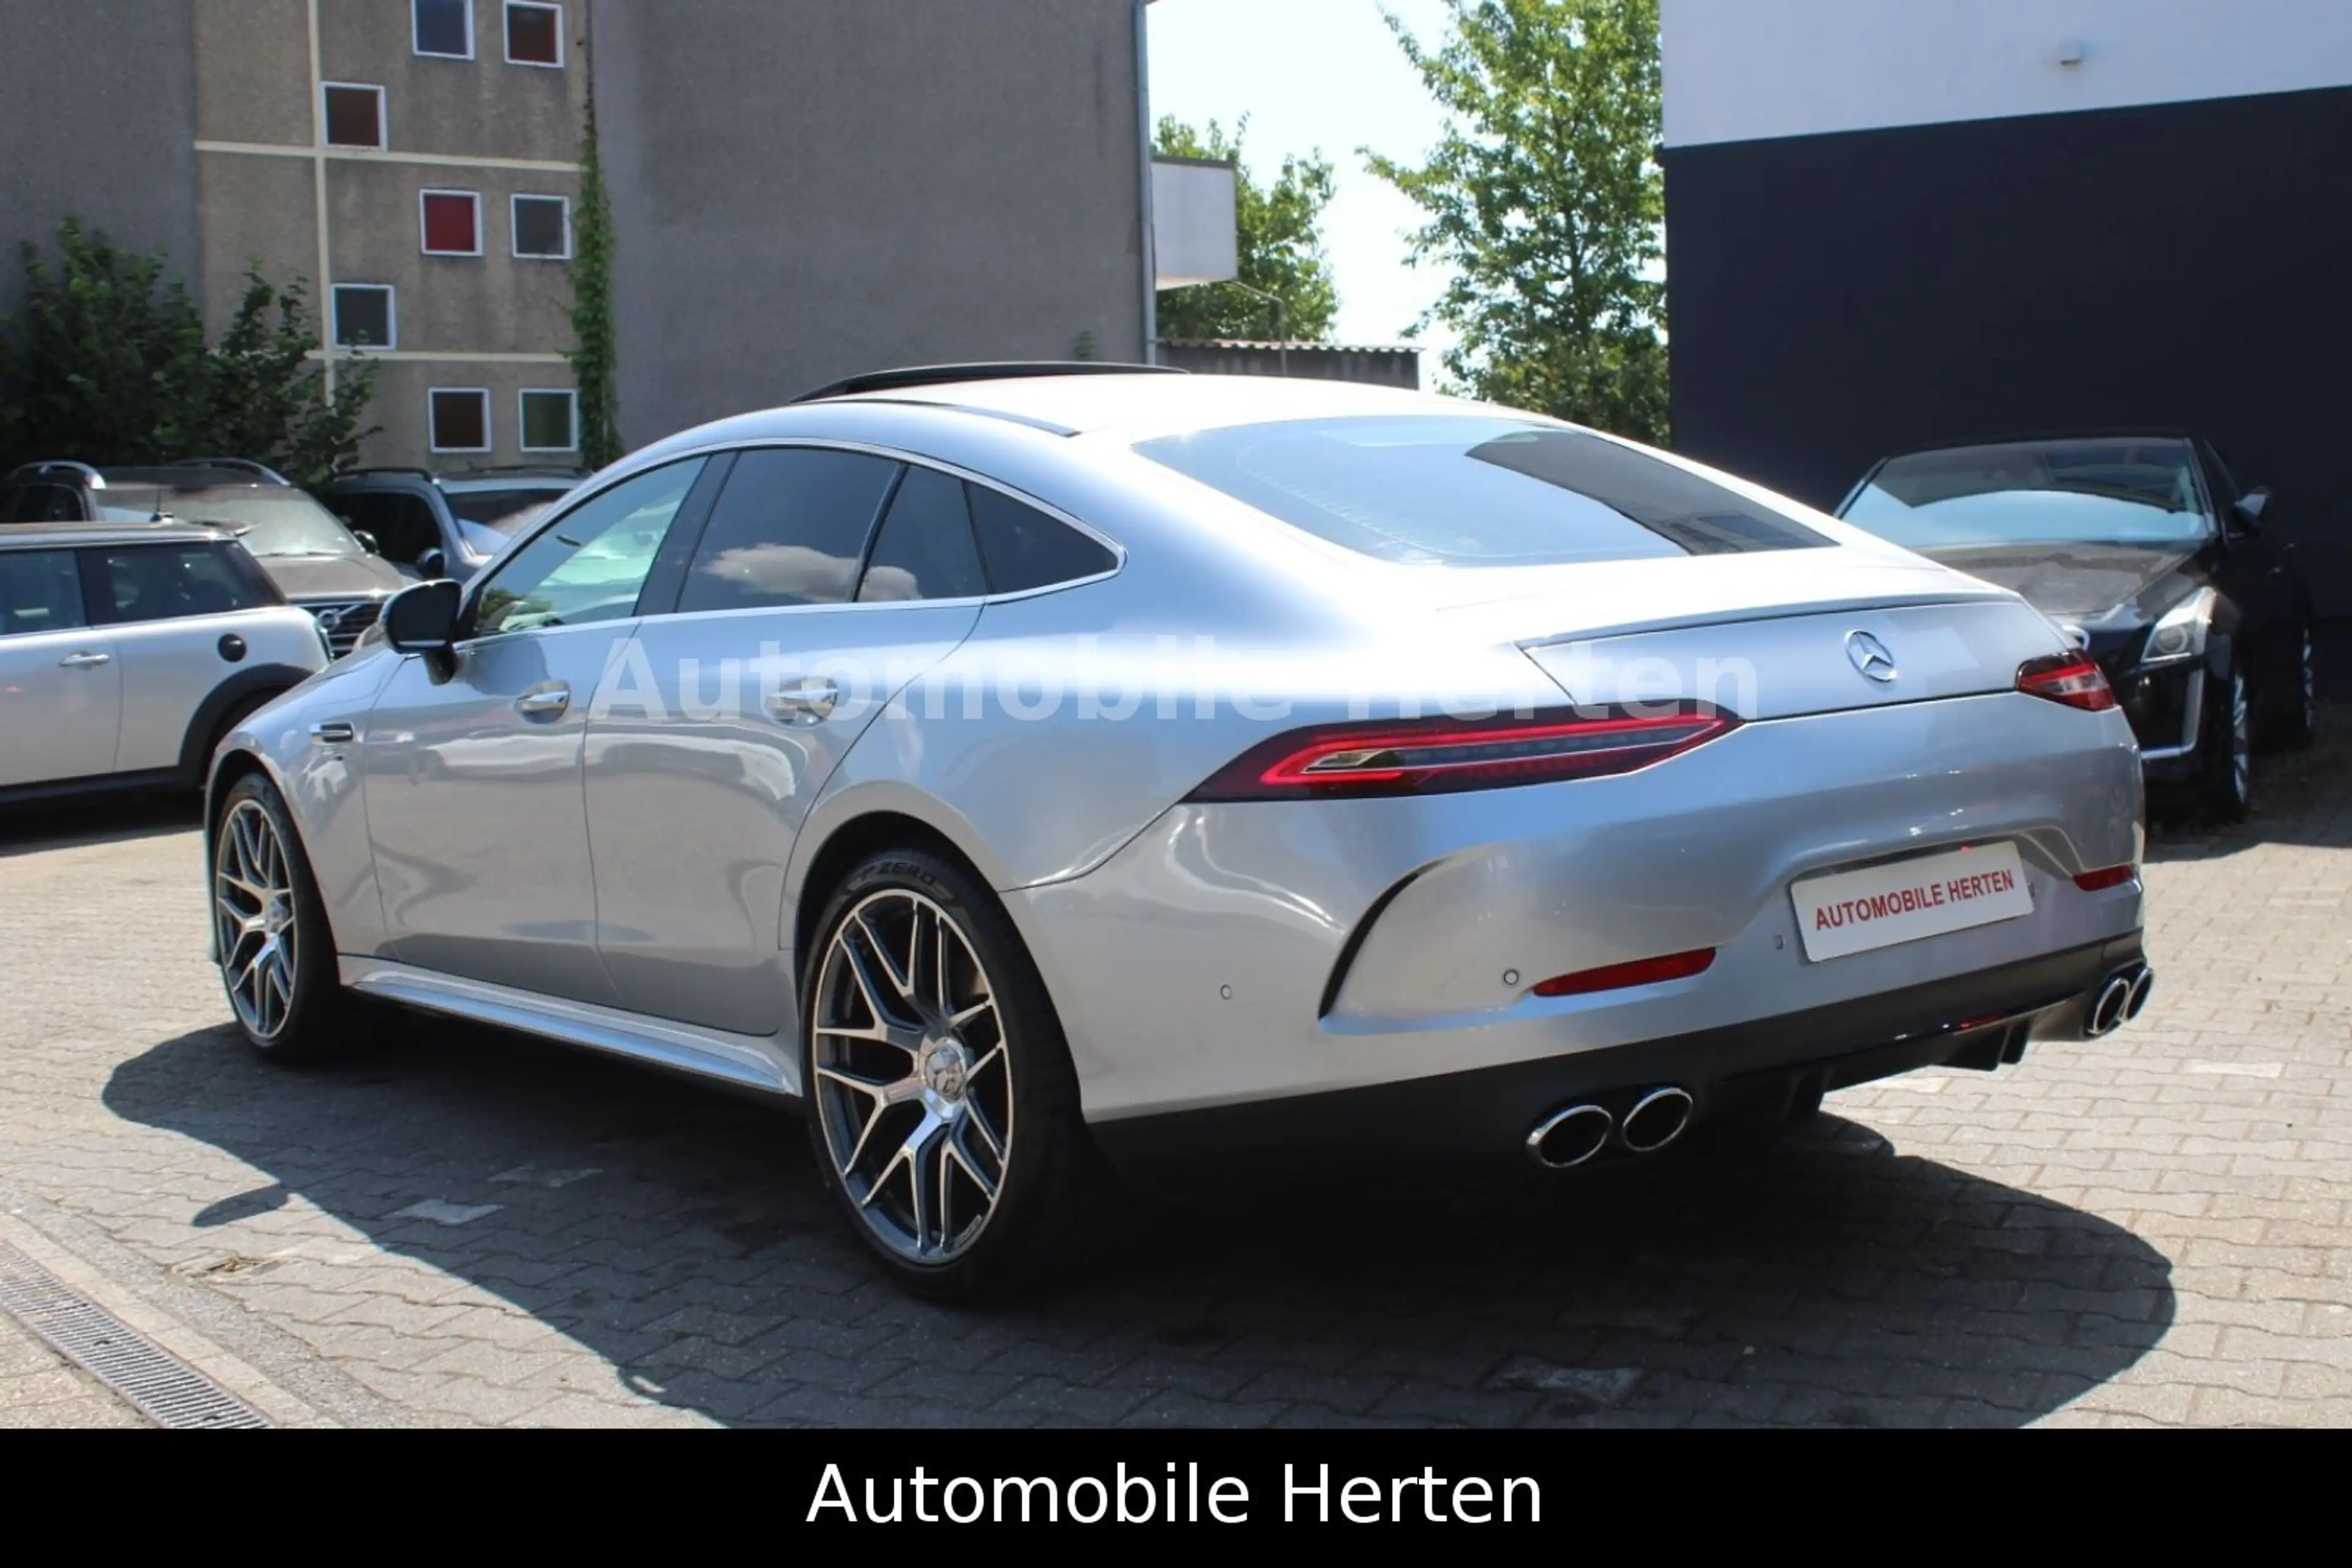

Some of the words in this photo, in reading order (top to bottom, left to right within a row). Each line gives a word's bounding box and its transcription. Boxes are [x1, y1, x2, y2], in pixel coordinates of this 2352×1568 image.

[878, 861, 935, 886] ZERO
[1815, 883, 1945, 930] AUTOMOBILE
[1947, 869, 2015, 903] HERTEN
